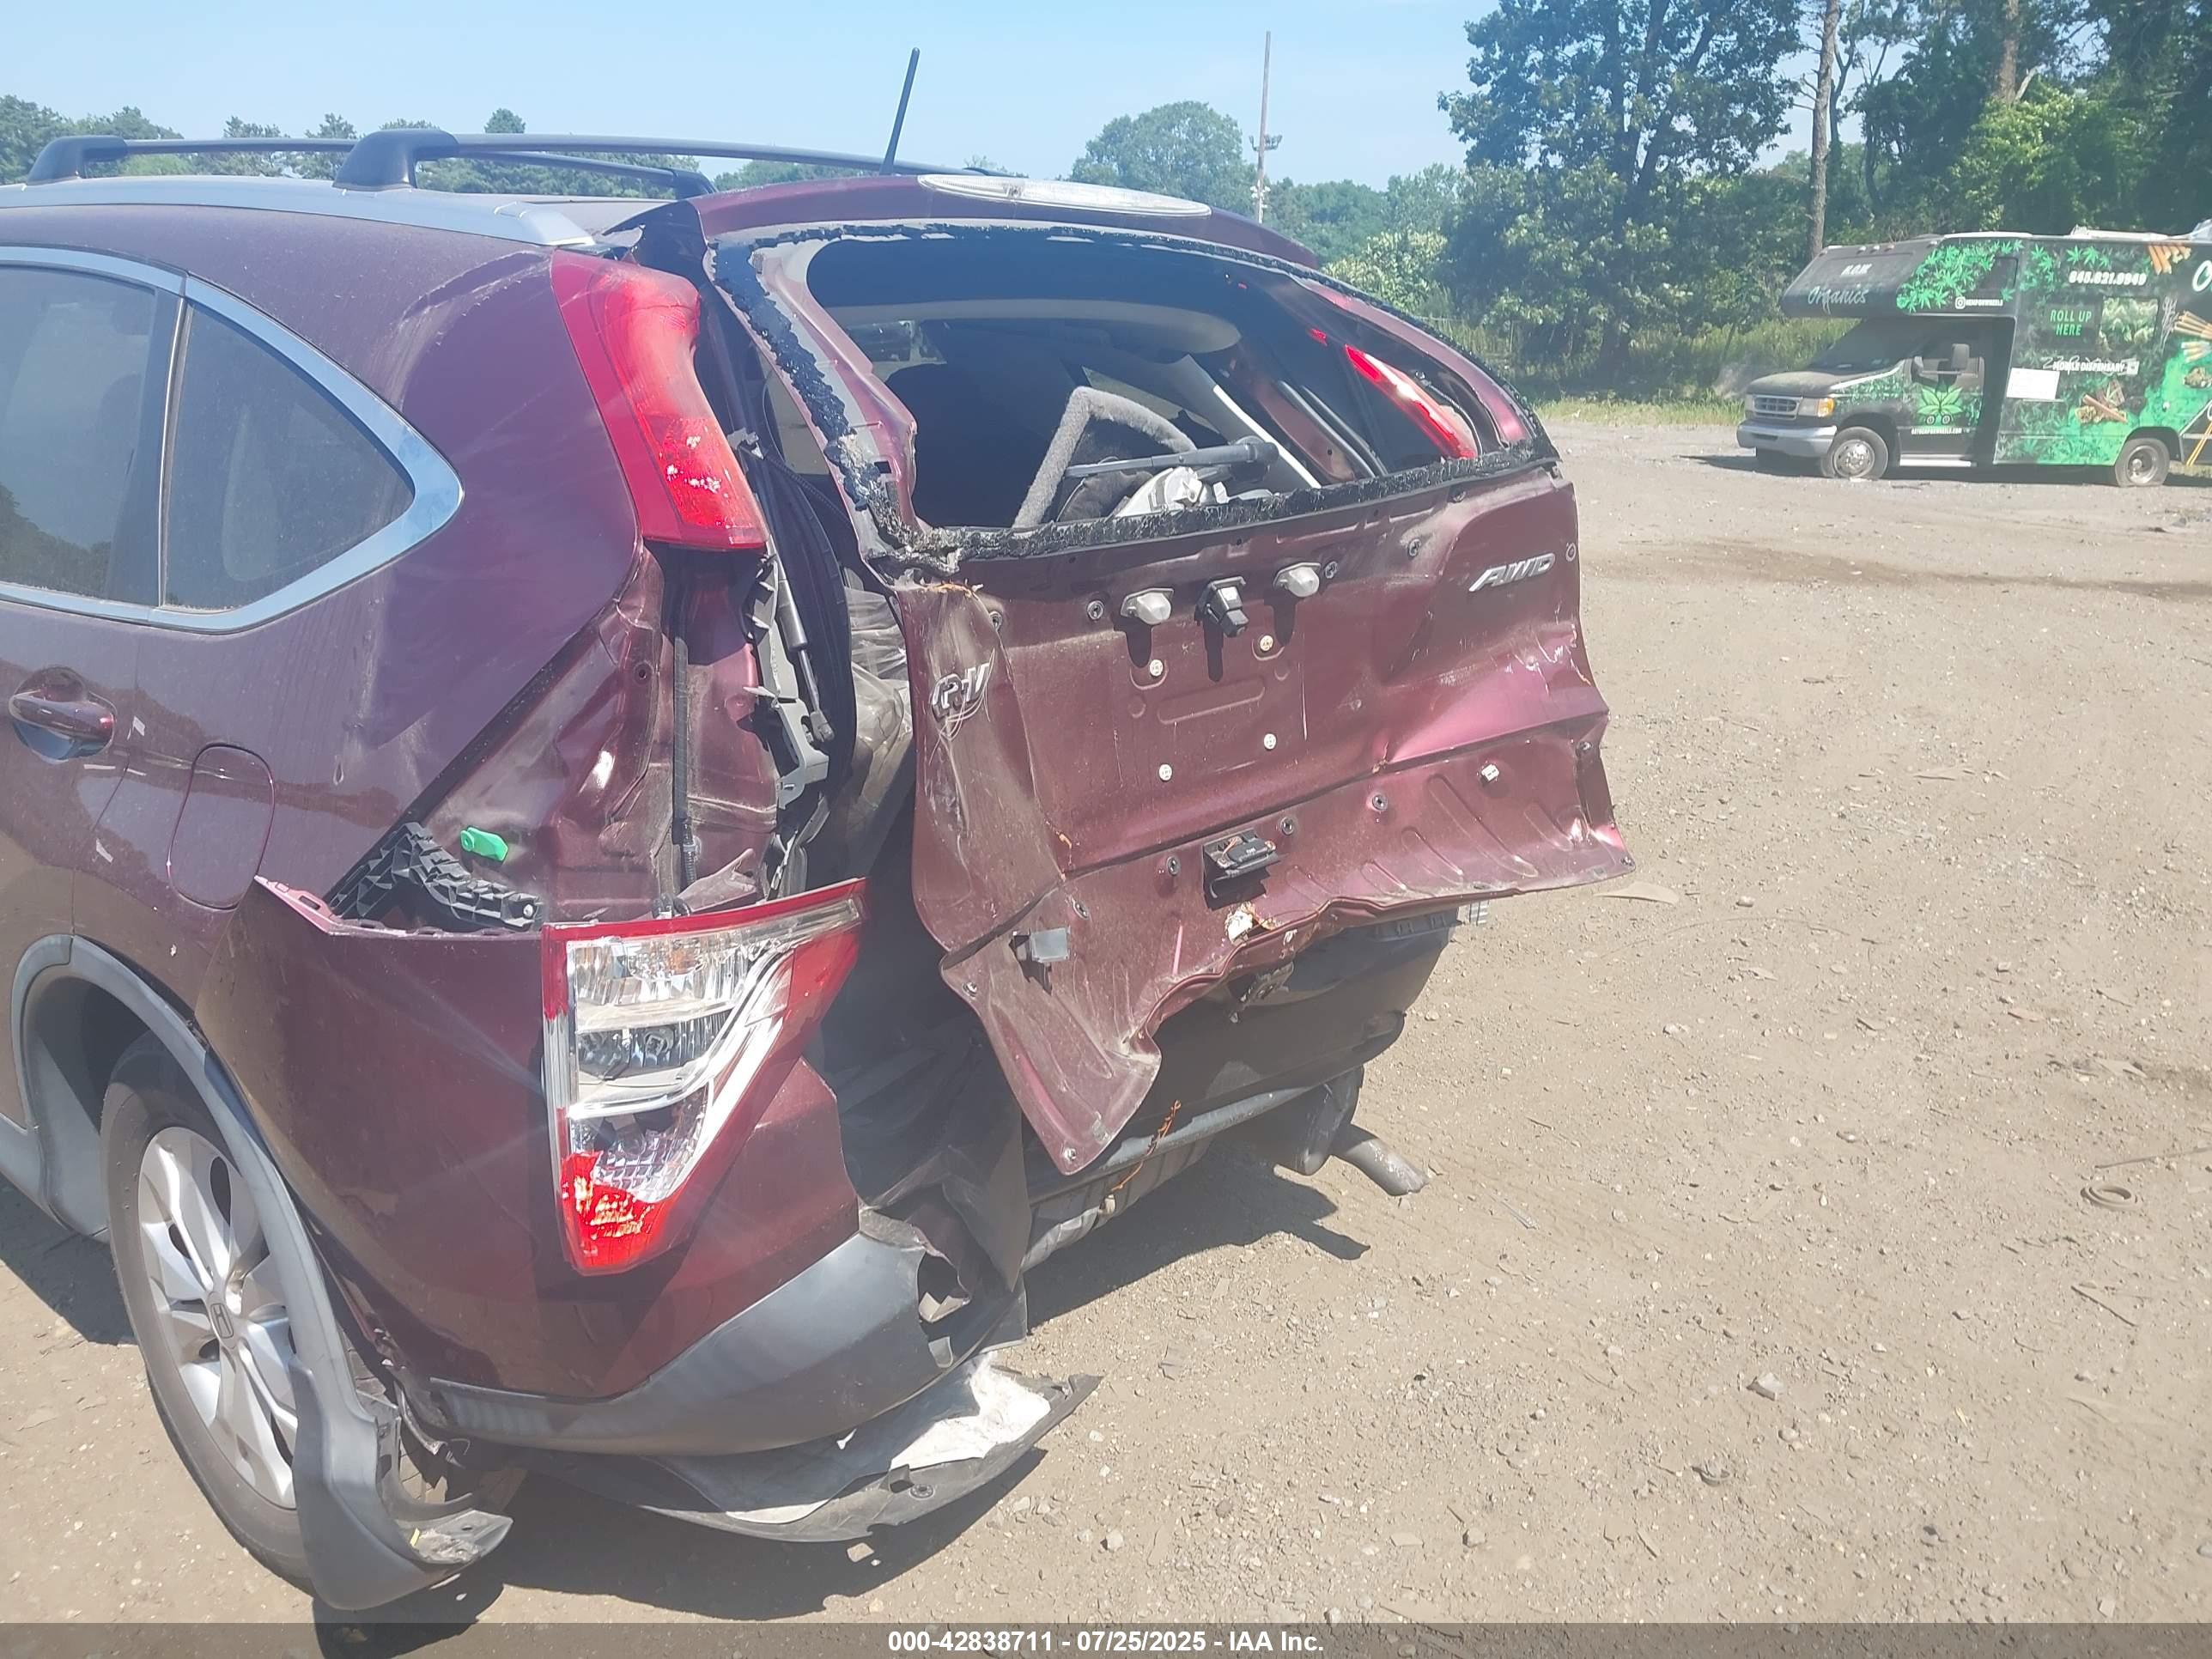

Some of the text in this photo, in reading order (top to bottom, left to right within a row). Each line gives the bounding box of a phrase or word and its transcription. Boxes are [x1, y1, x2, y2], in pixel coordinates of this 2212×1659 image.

[1807, 285, 1869, 315] Organics
[2050, 309, 2093, 323] ROLL UP
[2056, 324, 2082, 337] HERE
[1468, 552, 1556, 592] AWD
